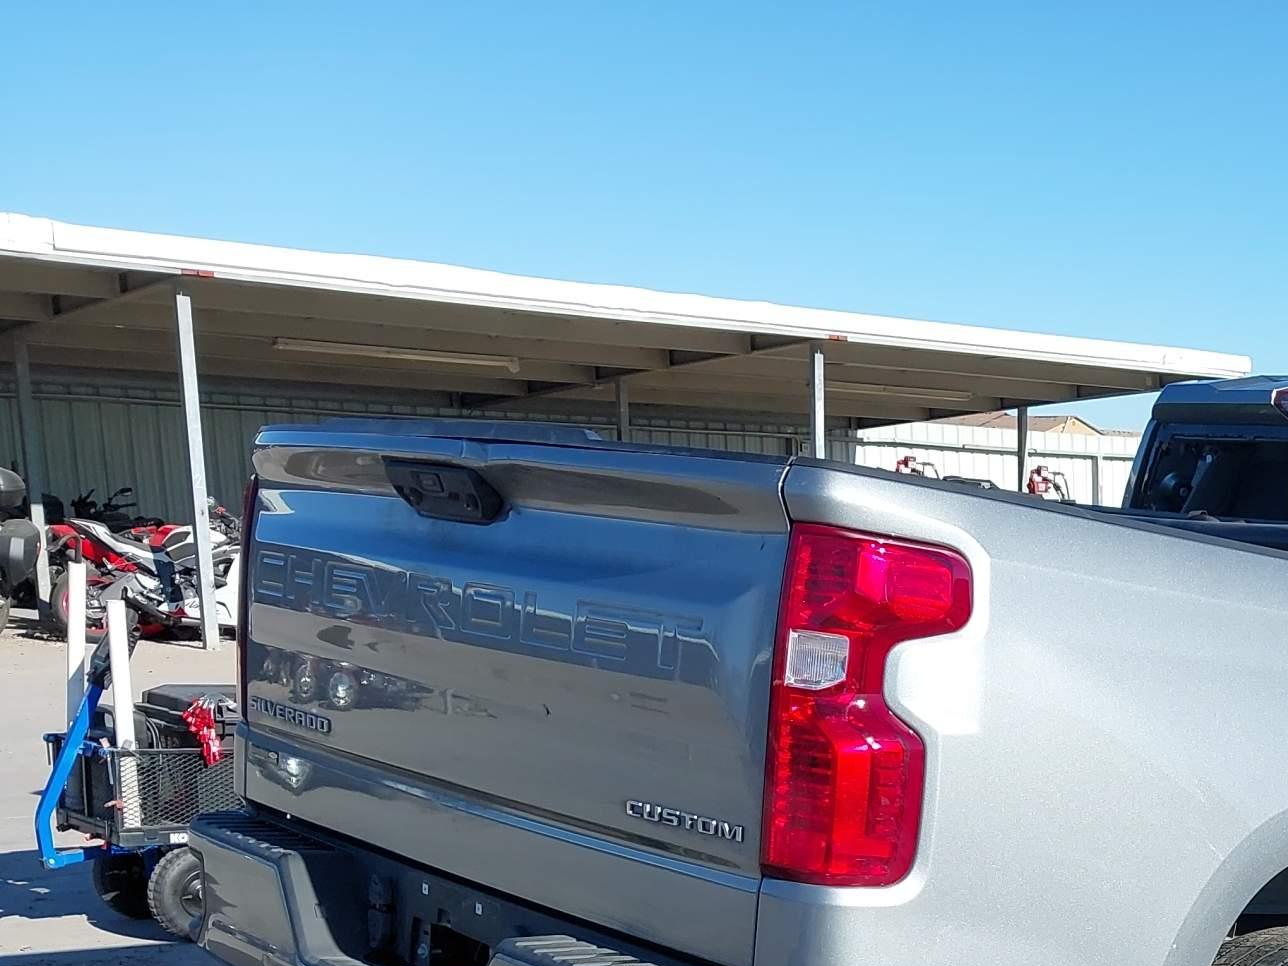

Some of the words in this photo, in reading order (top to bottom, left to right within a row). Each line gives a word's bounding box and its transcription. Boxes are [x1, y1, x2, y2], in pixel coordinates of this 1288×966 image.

[256, 550, 704, 676] CHEVROLET
[248, 696, 331, 733] SILVERADO
[626, 800, 743, 842] CUSTOM
